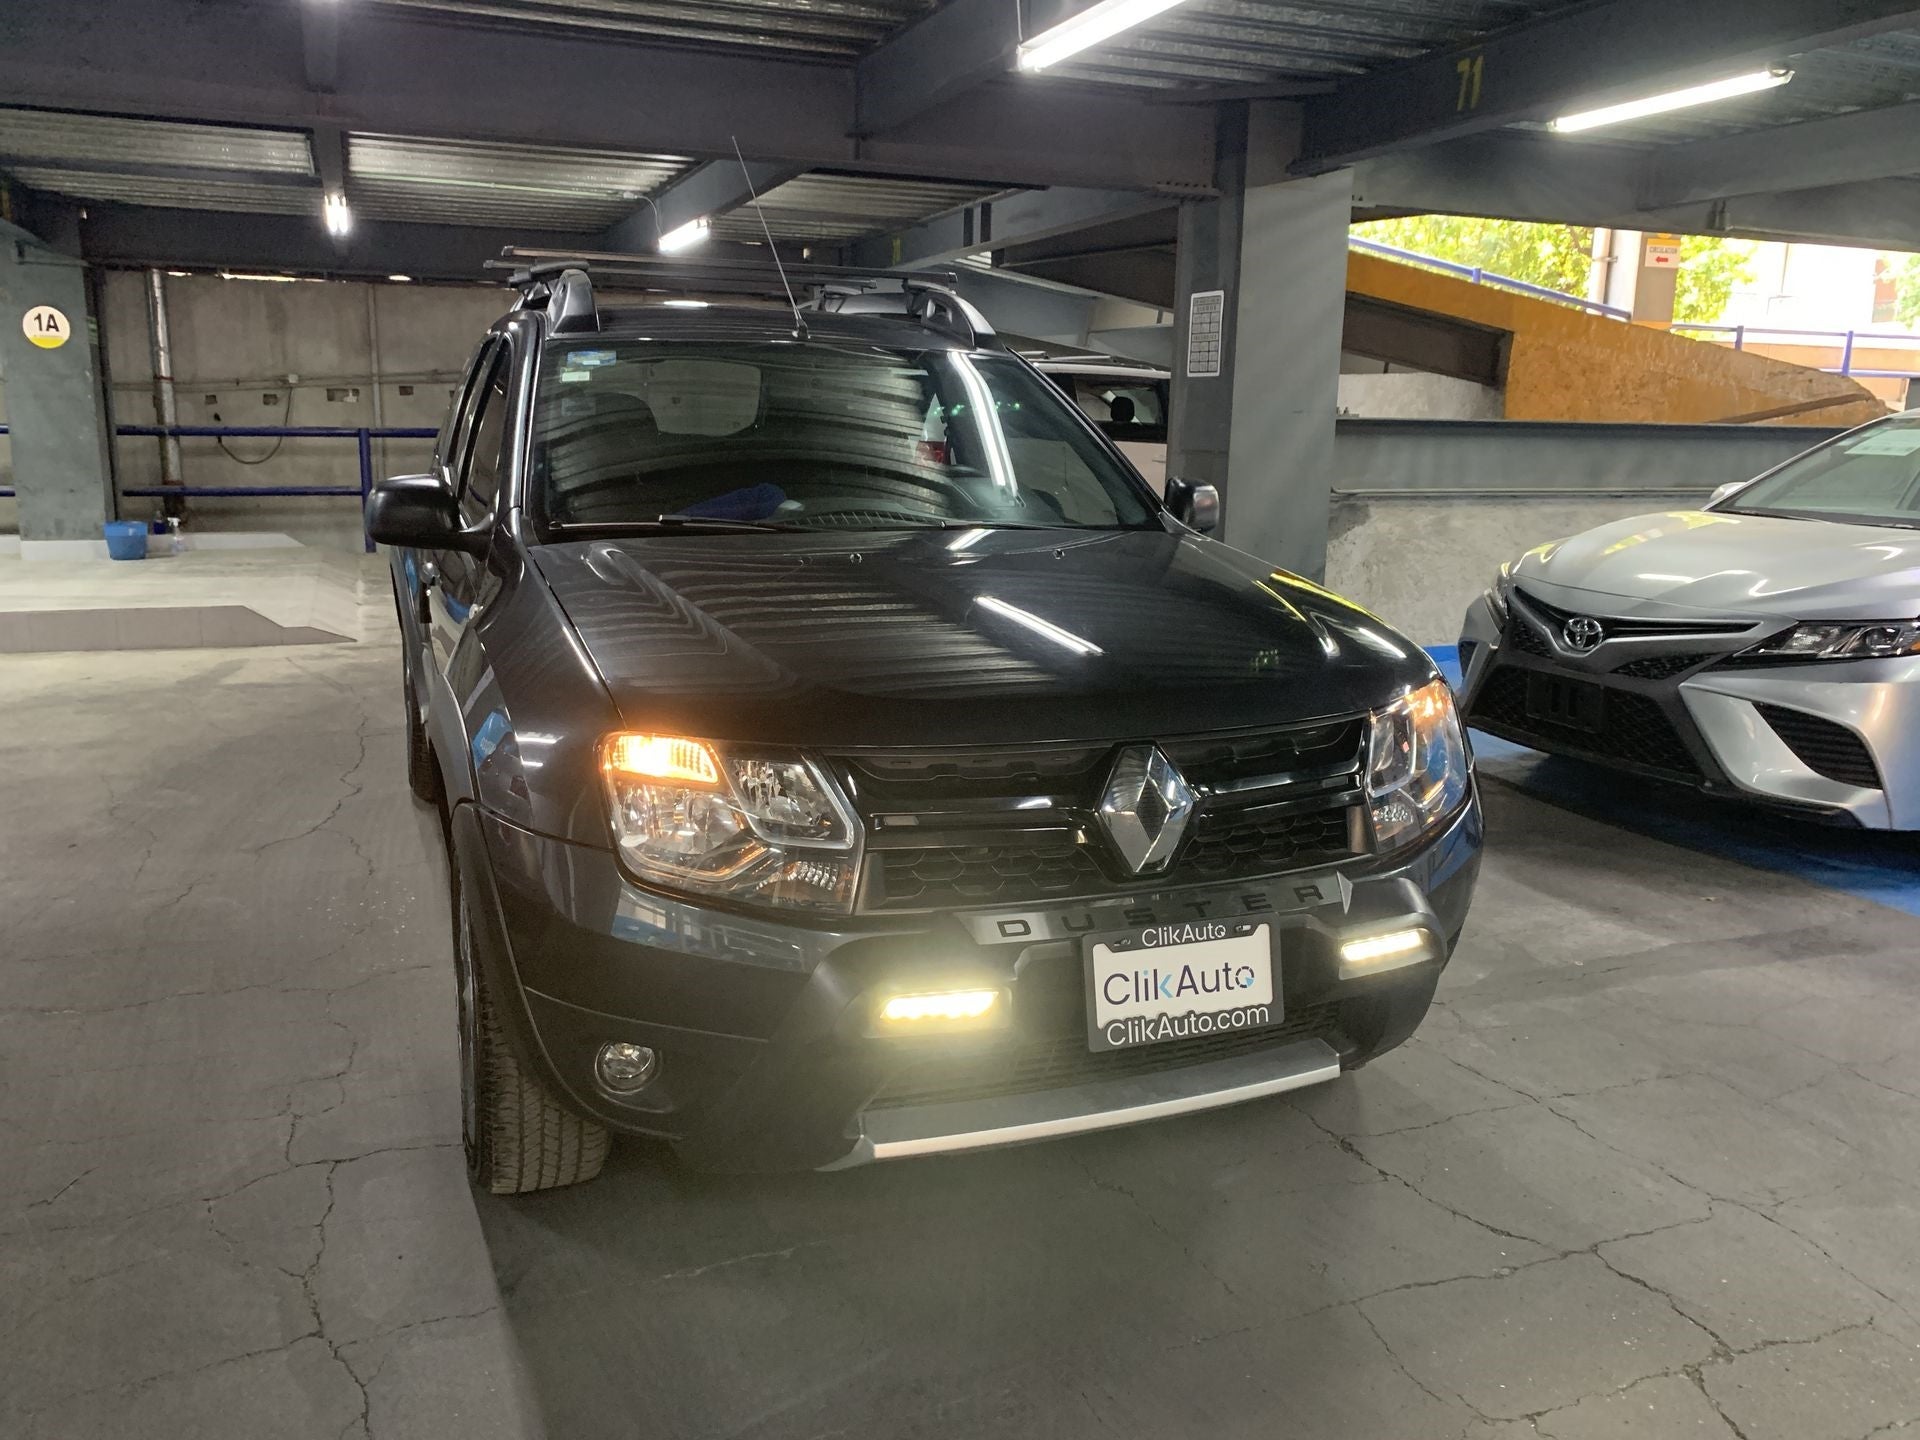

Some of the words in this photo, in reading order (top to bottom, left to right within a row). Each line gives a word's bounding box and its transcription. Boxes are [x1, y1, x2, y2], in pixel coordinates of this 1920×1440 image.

[1456, 55, 1484, 111] 71
[33, 312, 60, 332] 1A
[997, 884, 1325, 938] DUSTER
[1141, 923, 1227, 947] ClikAuto
[1103, 962, 1256, 1006] ClikAuto
[1106, 1006, 1270, 1046] ClikAuto.com
